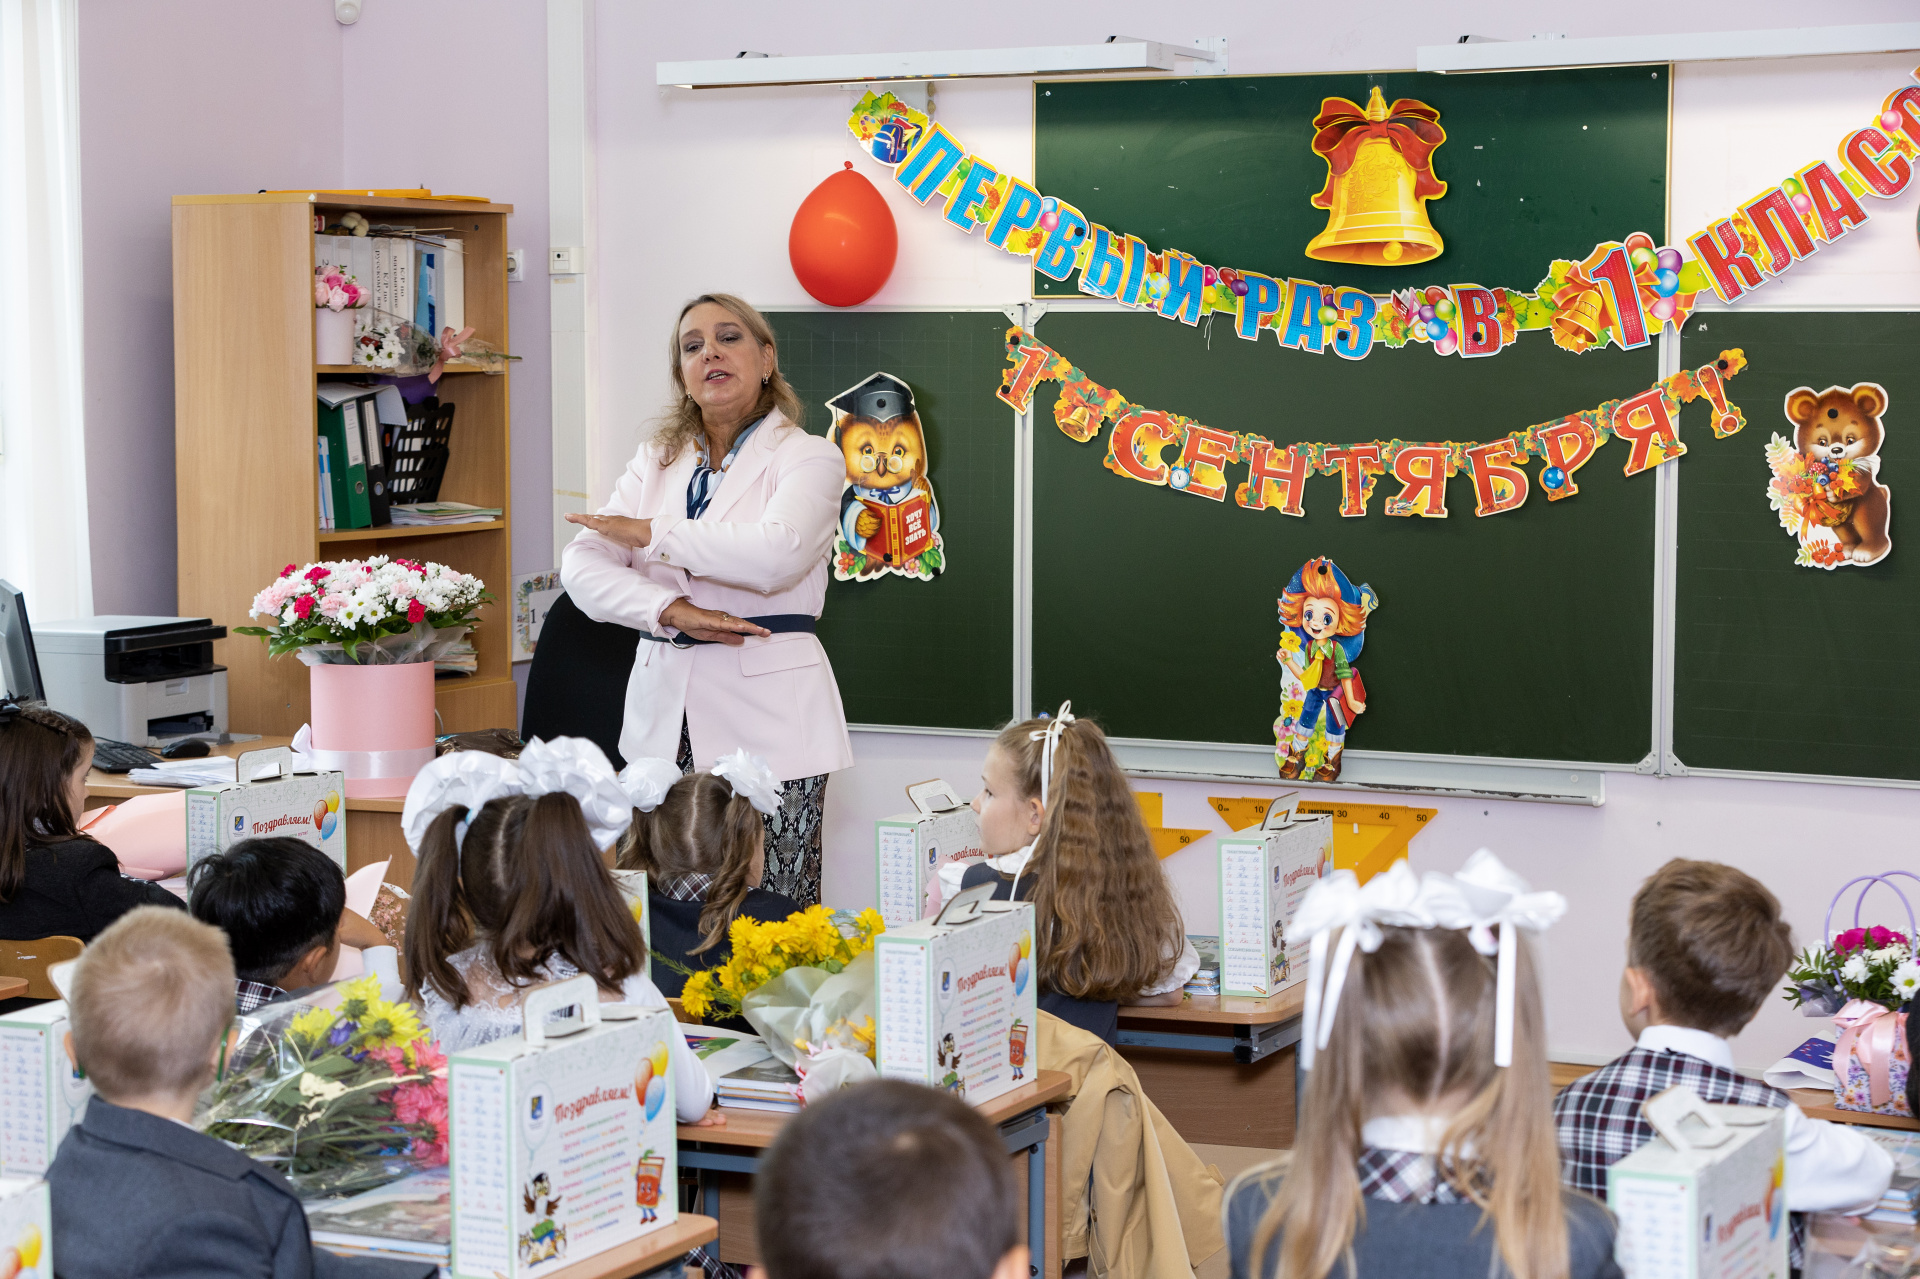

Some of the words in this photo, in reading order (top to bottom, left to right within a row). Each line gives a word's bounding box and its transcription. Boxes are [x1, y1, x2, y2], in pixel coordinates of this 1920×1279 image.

[894, 121, 1207, 328] ПЕРВЫЙ
[1234, 268, 1378, 361] РАЗ
[1449, 283, 1503, 358] В
[1580, 240, 1651, 351] 1
[995, 345, 1051, 415] 1
[905, 508, 923, 524] ХОЧУ
[908, 518, 922, 533] ВСЁ
[904, 528, 927, 546] ЗНАТЬ
[1254, 805, 1264, 814] 10
[1336, 810, 1348, 818] 30
[1379, 811, 1390, 821] 40
[1416, 813, 1428, 823] 50
[252, 813, 313, 835] Поздравляем!
[1179, 835, 1190, 844] 50
